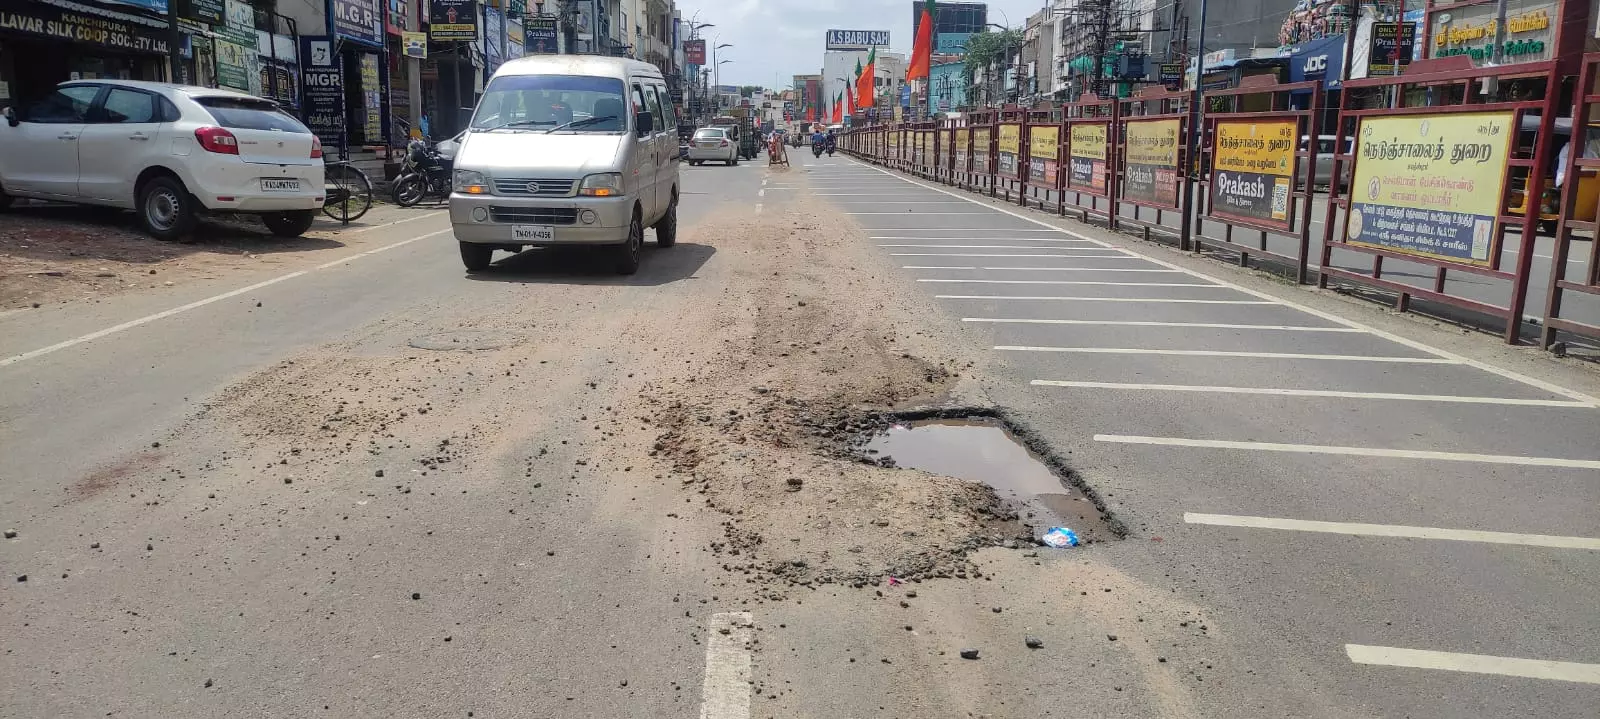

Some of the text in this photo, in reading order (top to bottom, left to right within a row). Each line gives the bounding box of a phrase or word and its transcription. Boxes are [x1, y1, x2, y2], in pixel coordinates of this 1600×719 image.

[61, 13, 135, 34] KANCHIPURA
[334, 3, 373, 28] M.G.R
[47, 20, 73, 38] SILK
[76, 26, 108, 44] CO-OP
[830, 31, 888, 45] A.S.BABU SAH
[1505, 39, 1545, 56] Fabrics
[1303, 54, 1328, 72] JDC
[306, 73, 341, 86] MGR
[1363, 136, 1492, 164] நெடுஞ்சாலைத் துறை
[1218, 172, 1265, 198] Prakash
